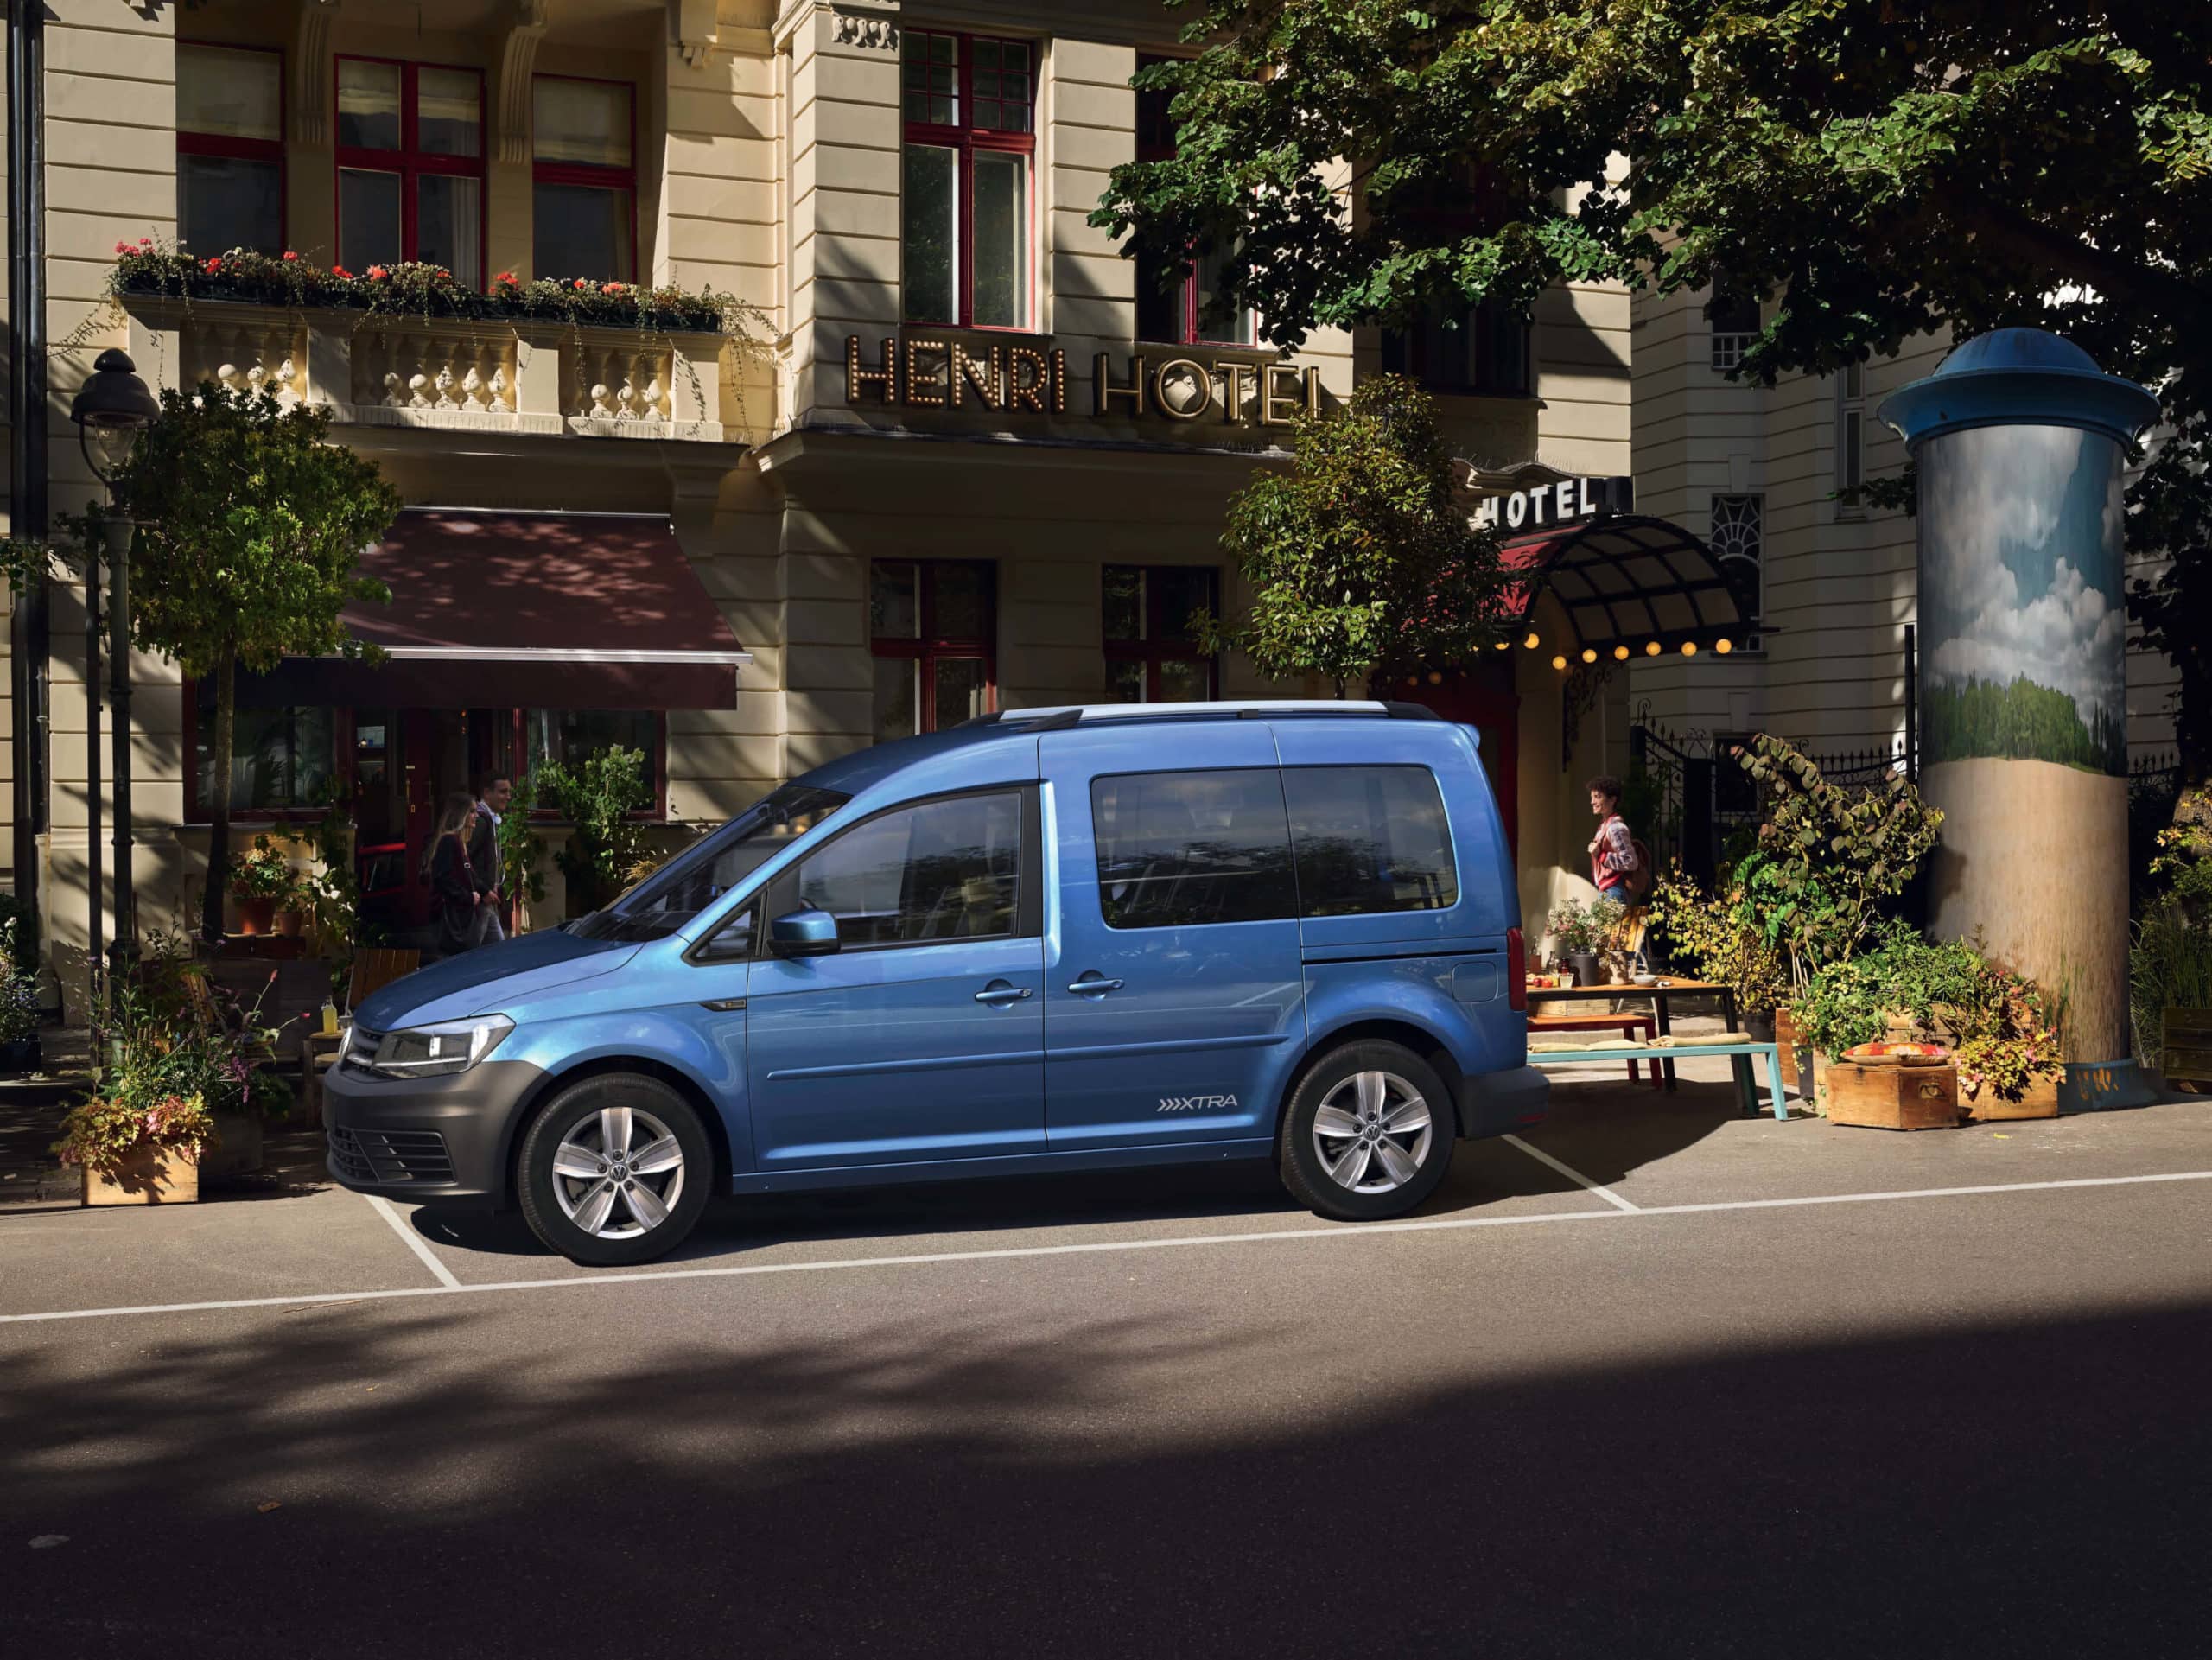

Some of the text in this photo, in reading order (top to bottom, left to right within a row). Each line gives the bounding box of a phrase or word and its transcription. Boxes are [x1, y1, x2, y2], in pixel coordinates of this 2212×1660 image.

[846, 334, 1066, 413] HENRI
[1482, 477, 1596, 528] HOTEL
[1178, 1094, 1238, 1110] XTRA
